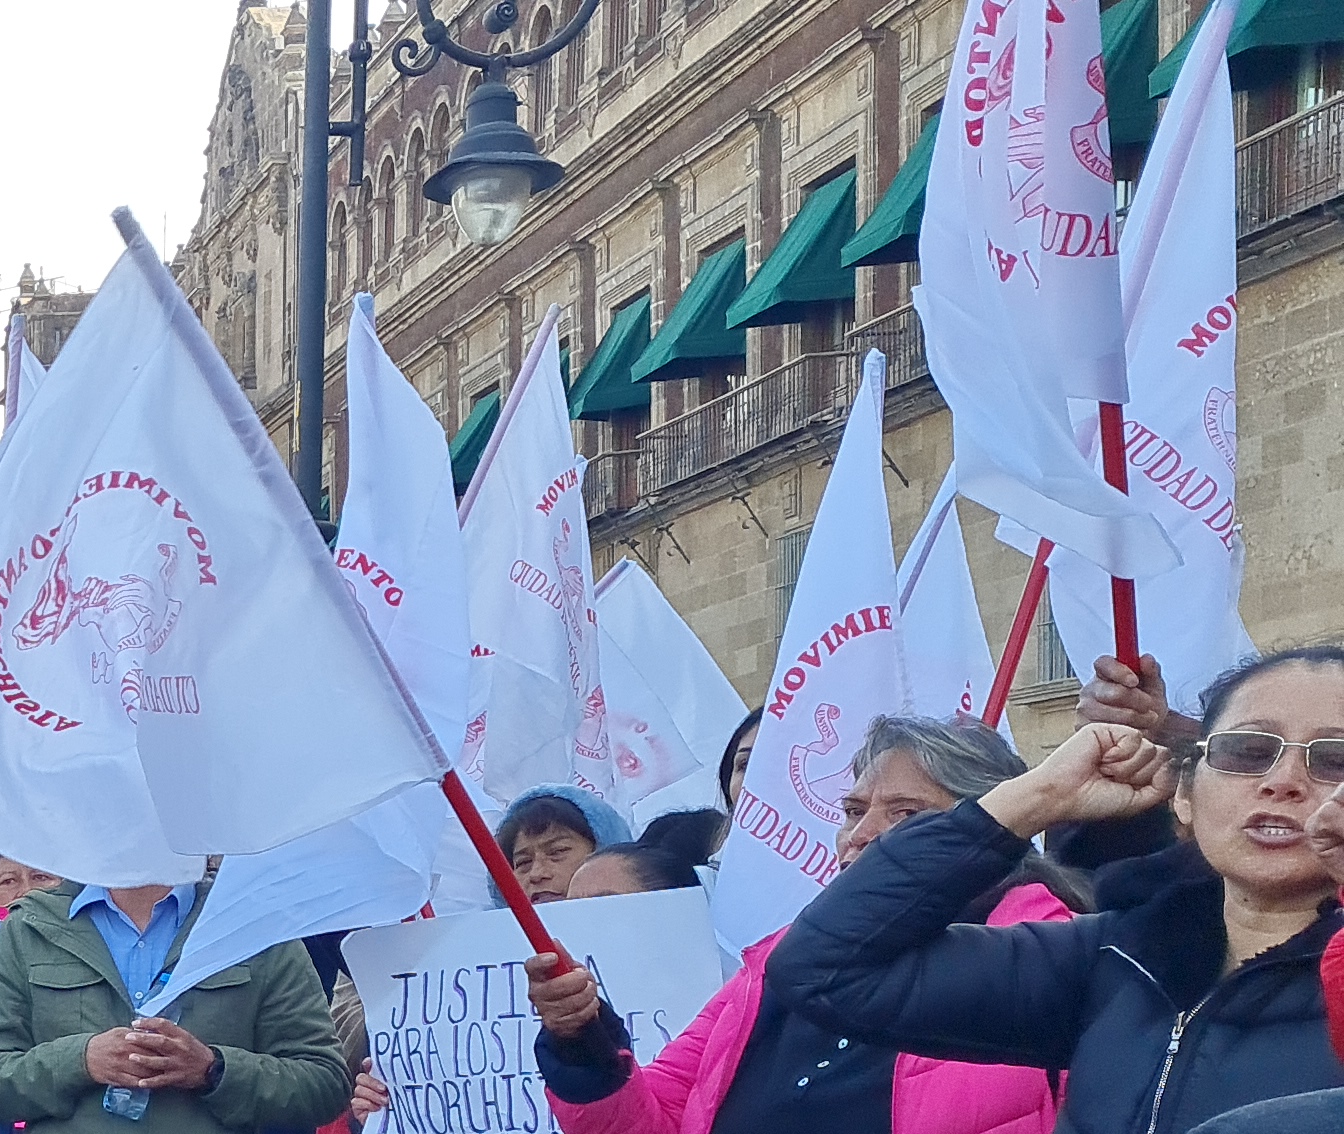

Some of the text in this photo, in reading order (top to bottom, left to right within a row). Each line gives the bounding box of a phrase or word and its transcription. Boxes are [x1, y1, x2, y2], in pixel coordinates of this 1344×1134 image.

[767, 605, 893, 720] MOVIMIE
[733, 786, 808, 862] IUDAD
[375, 1026, 447, 1085] PARA
[453, 1020, 506, 1078] LOS
